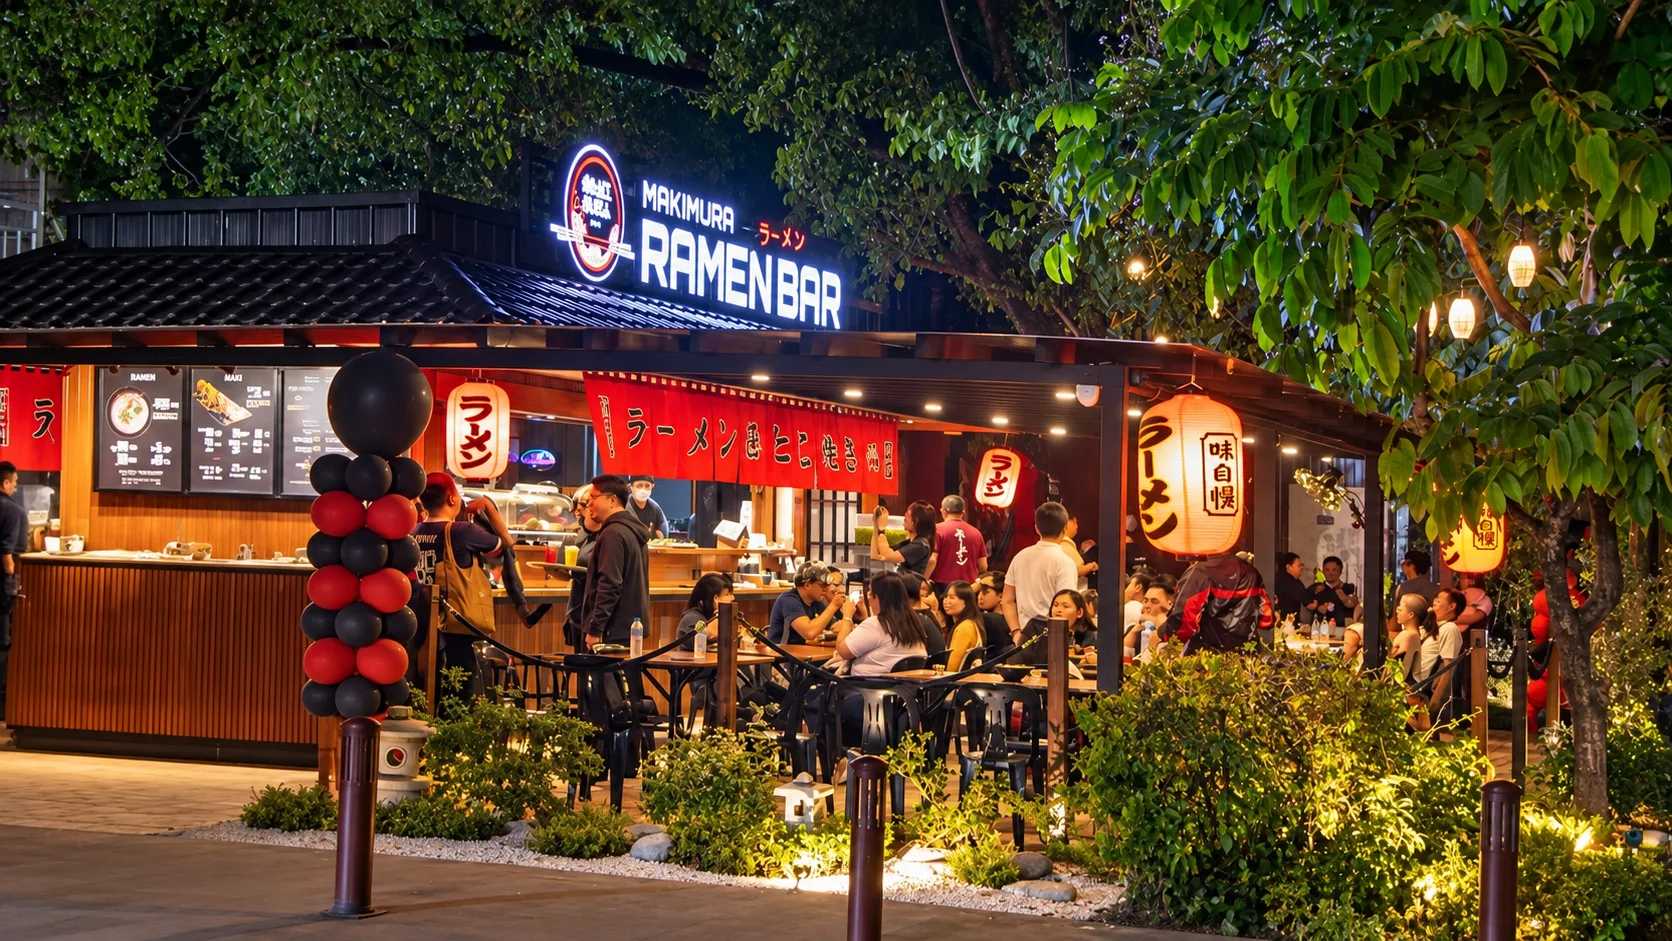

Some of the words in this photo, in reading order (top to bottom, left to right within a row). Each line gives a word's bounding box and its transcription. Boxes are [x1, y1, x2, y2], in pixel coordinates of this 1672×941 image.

[642, 180, 735, 234] MAKIMURA
[758, 221, 806, 252] ラーメン
[640, 218, 773, 314] RAMEN
[776, 257, 842, 330] BAR
[459, 395, 493, 470] ラーメン
[983, 454, 1012, 498] ラーメン
[1139, 415, 1178, 540] ラーメン
[1209, 440, 1235, 510] 味自慢
